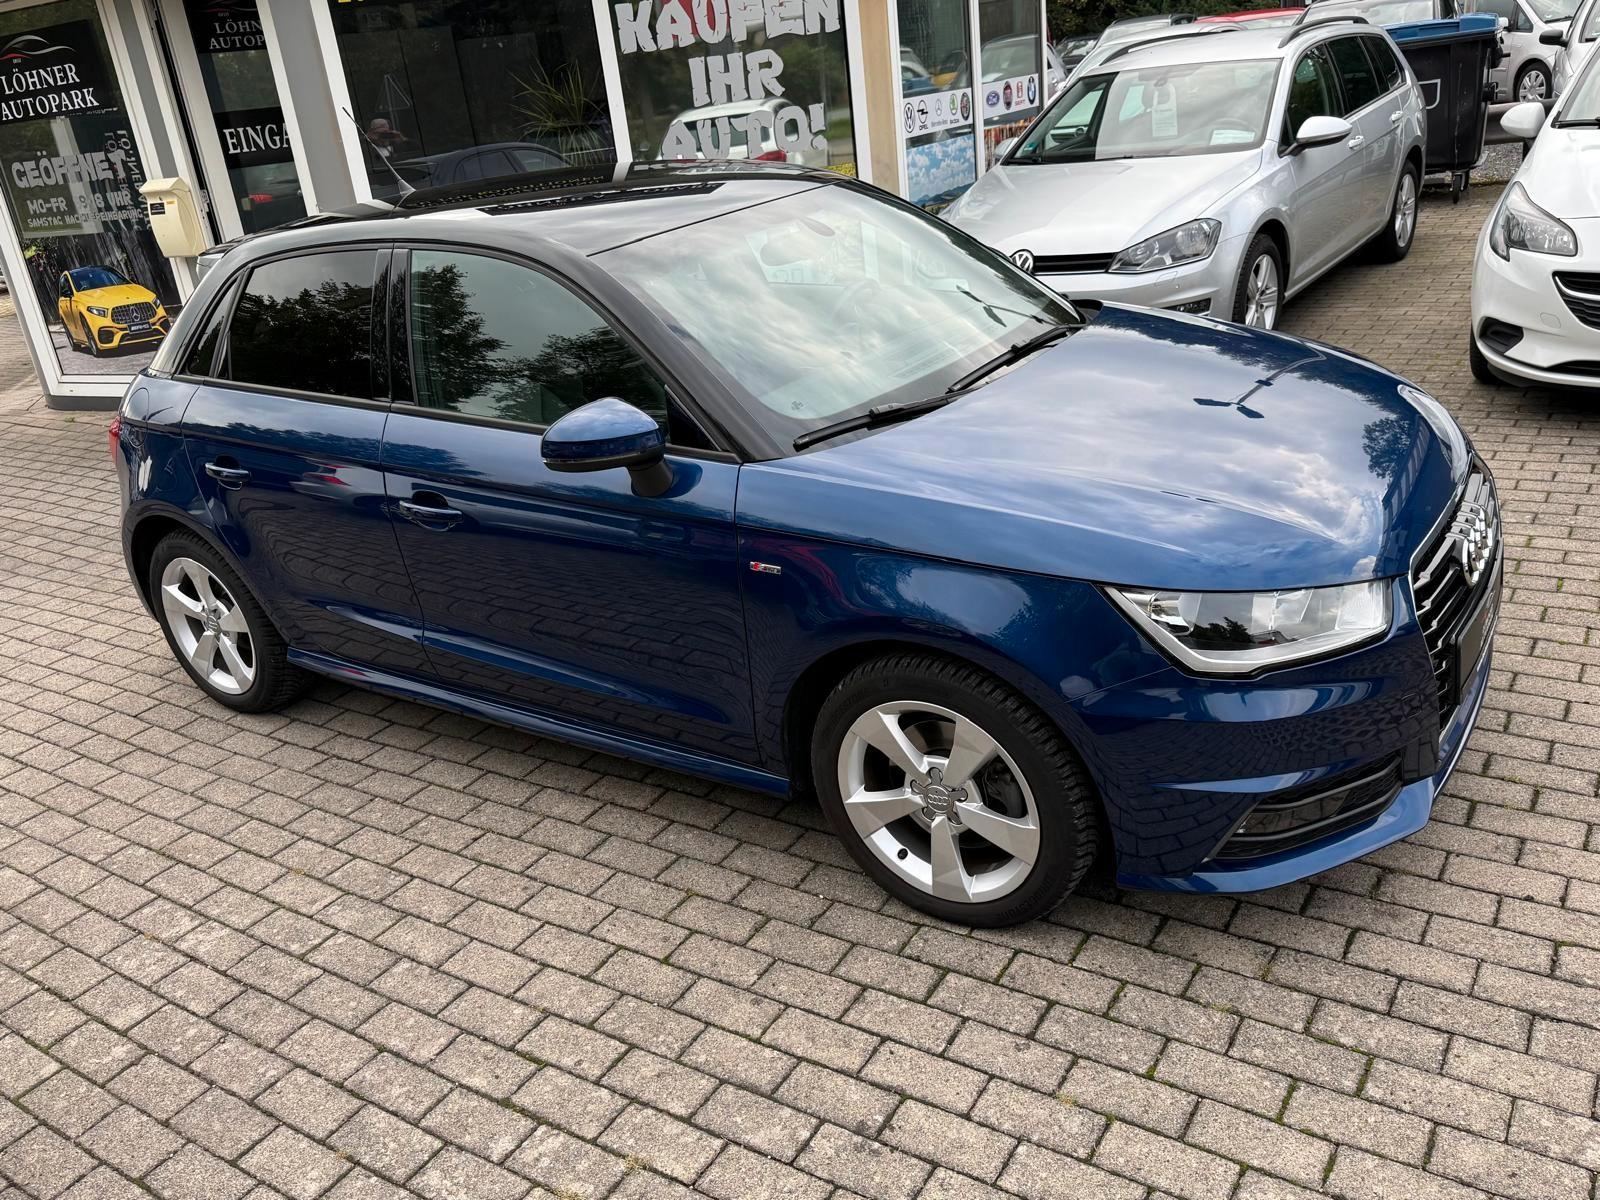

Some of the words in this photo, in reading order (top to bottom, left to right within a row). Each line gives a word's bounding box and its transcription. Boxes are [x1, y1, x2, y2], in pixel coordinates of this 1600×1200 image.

[614, 0, 841, 54] KAUFEN
[0, 63, 80, 95] LÖHNER
[688, 49, 786, 107] IHR
[1, 88, 99, 120] AUTOPARK
[661, 103, 828, 160] AUTO!
[11, 149, 126, 188] GEÖFFNET
